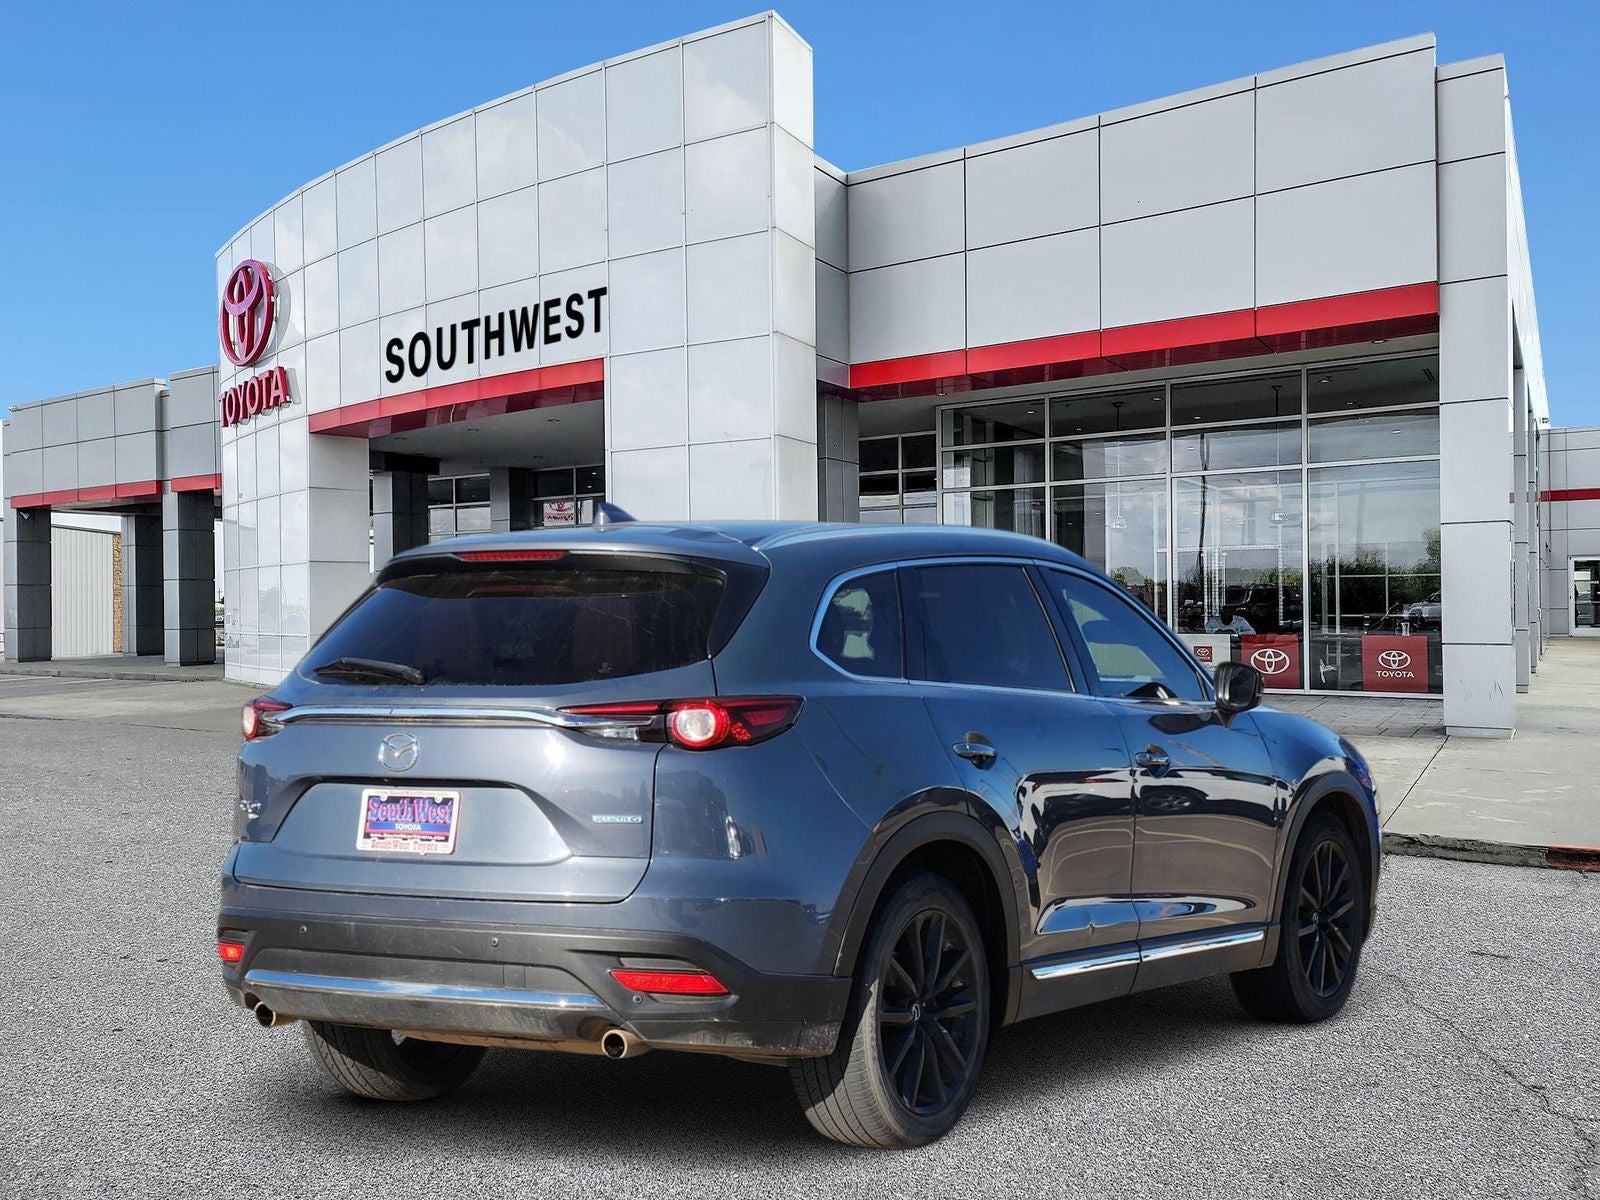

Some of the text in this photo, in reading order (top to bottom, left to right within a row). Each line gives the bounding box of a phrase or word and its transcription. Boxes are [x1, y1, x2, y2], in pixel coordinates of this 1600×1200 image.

[385, 287, 608, 384] SOUTHWEST
[218, 366, 291, 428] TOYOTA
[1375, 670, 1415, 678] TOYOTA
